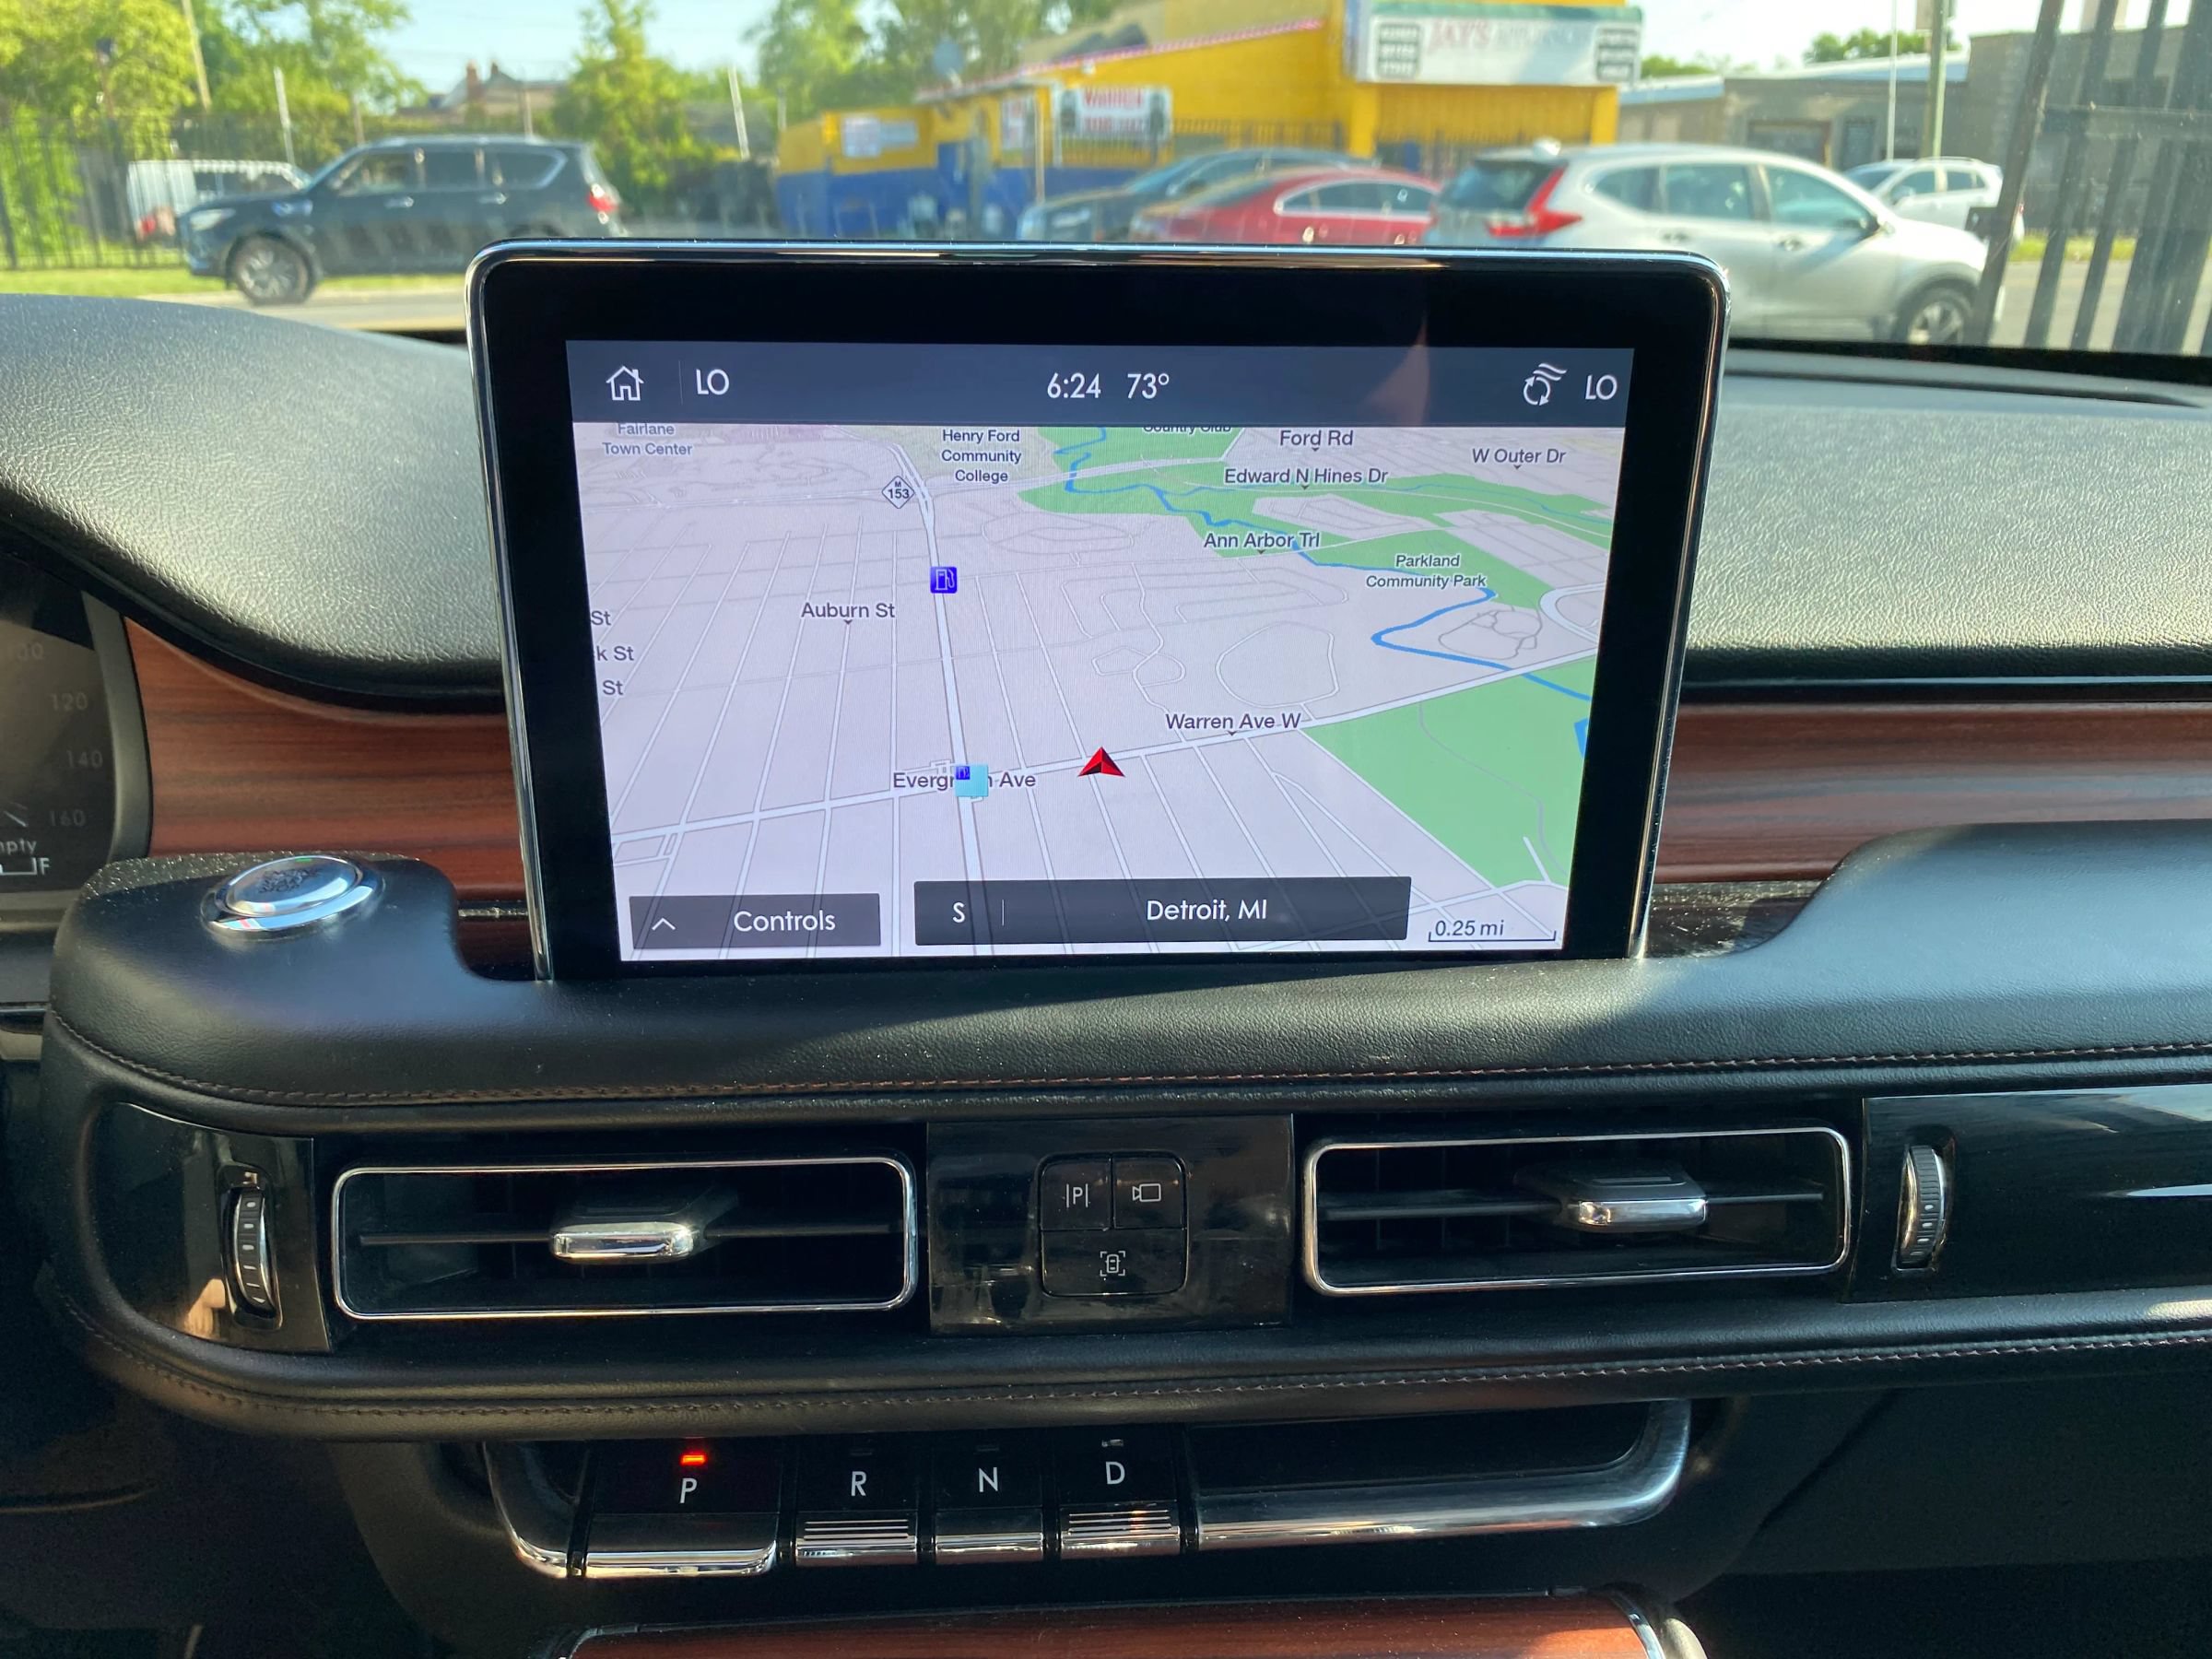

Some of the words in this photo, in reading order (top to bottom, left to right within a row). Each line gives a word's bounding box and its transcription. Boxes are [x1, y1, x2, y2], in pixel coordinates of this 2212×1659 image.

[696, 369, 730, 395] LO
[1046, 372, 1101, 399] 6:24
[1126, 372, 1171, 399] 73°
[1585, 374, 1618, 400] LO
[618, 422, 675, 435] Fairlane
[942, 429, 983, 446] Henry
[987, 429, 1020, 443] Ford
[1279, 430, 1322, 447] Ford
[1327, 430, 1354, 446] Rd
[602, 442, 641, 455] Town
[645, 442, 693, 455] Center
[1472, 449, 1490, 464] W
[1494, 449, 1542, 464] Outer
[1547, 449, 1567, 464] Dr
[941, 449, 1022, 465] Community
[955, 469, 1008, 485] College
[1224, 468, 1290, 484] Edward
[1296, 468, 1310, 484] N
[1314, 468, 1363, 484] Hines
[1368, 468, 1389, 484] Dr
[888, 488, 910, 499] 153
[1204, 533, 1239, 548] Ann
[1242, 532, 1293, 548] Arbor
[1297, 532, 1321, 547] Trl
[1395, 554, 1461, 568] Parkland
[1366, 574, 1450, 590] Community
[1453, 574, 1487, 588] Park
[591, 610, 612, 626] St
[801, 603, 870, 618] Auburn
[875, 603, 896, 618] St
[613, 645, 634, 661] St
[603, 680, 624, 695] St
[1165, 713, 1234, 729] Warren
[1239, 713, 1275, 729] Ave
[1281, 713, 1301, 728] W
[893, 772, 993, 791] Evergrn
[999, 771, 1036, 788] Ave
[40, 857, 50, 875] F
[952, 902, 966, 923] S
[1146, 900, 1230, 923] Detroit,
[1239, 899, 1267, 921] MI
[734, 909, 836, 933] Controls
[1435, 921, 1477, 936] 0.25
[1480, 920, 1504, 936] mi
[978, 1466, 999, 1493] N
[1105, 1461, 1126, 1486] D
[679, 1477, 698, 1503] P
[850, 1470, 867, 1497] R
